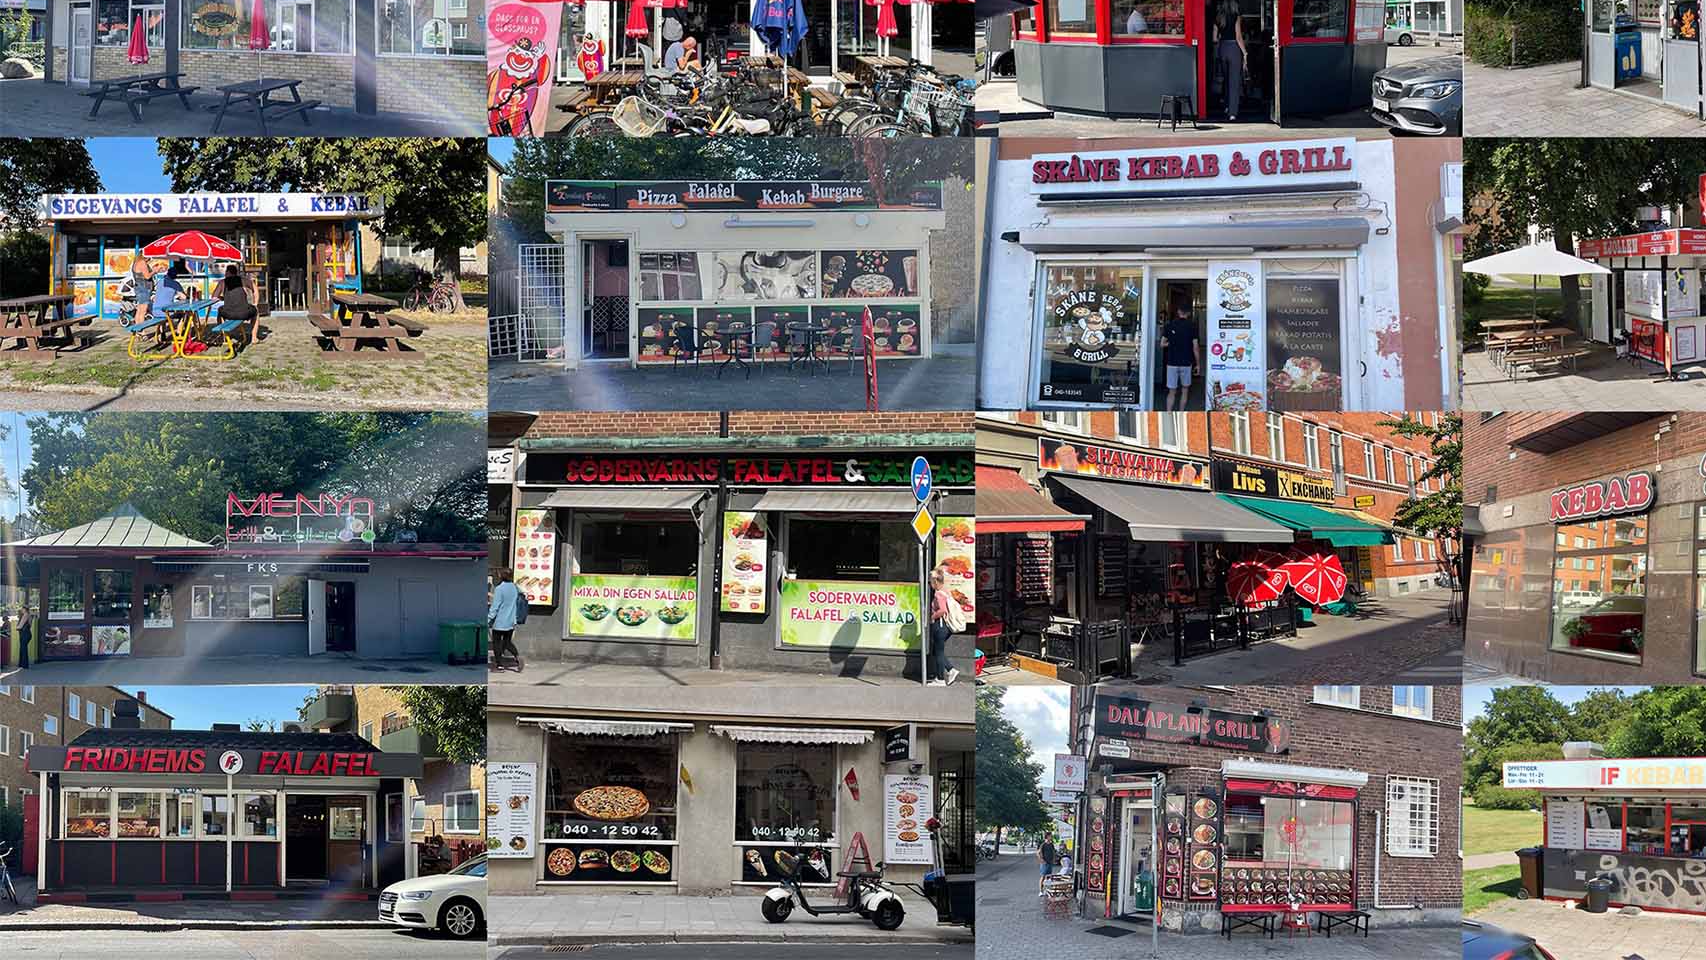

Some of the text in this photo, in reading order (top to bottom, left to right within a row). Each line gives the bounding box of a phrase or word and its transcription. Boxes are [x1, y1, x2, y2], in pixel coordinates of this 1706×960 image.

[1032, 145, 1353, 183] SKÅNE KEBAB & GRILL
[637, 182, 864, 206] Pizza Falafel Kebab Burgare
[51, 197, 289, 215] SEGEVANGS FALAFEL &
[1055, 291, 1098, 318] SKÅNE
[1081, 348, 1110, 362] GRILL
[566, 455, 866, 483] SÖDERVARNS FALAFEL &
[1087, 446, 1175, 473] SHAWARMA
[1232, 472, 1266, 493] Livs
[1292, 482, 1336, 501] EXCHANGE
[1549, 471, 1654, 523] KEBAB
[574, 587, 696, 601] MIXA DIN EGEN SALLAD
[809, 589, 896, 607] SÖDERVARNS
[791, 608, 915, 625] FALAFEL SALLAD
[1107, 703, 1211, 736] DALAPLANS
[1214, 717, 1262, 742] GRILL
[64, 747, 384, 777] FRIDHEMS FALAFEL
[1600, 765, 1703, 785] IF KEBAB
[563, 825, 659, 836] 040 12 50 42
[752, 827, 821, 837] 040 42
